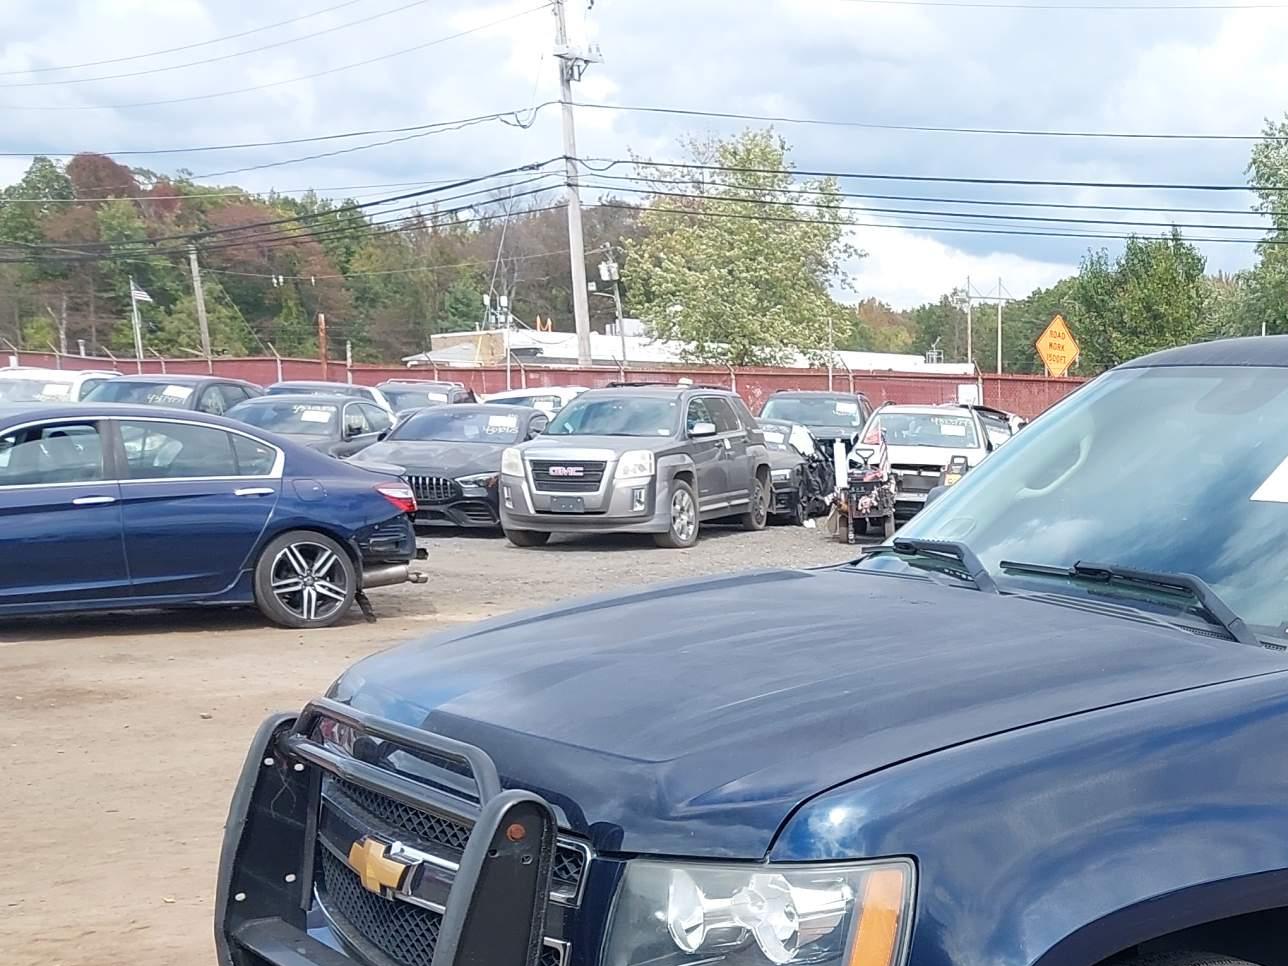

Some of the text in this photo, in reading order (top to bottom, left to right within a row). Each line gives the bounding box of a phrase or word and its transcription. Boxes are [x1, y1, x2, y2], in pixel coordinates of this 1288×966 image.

[1050, 330, 1065, 340] ROAD
[1049, 342, 1064, 351] WORK
[549, 466, 584, 476] GMC
